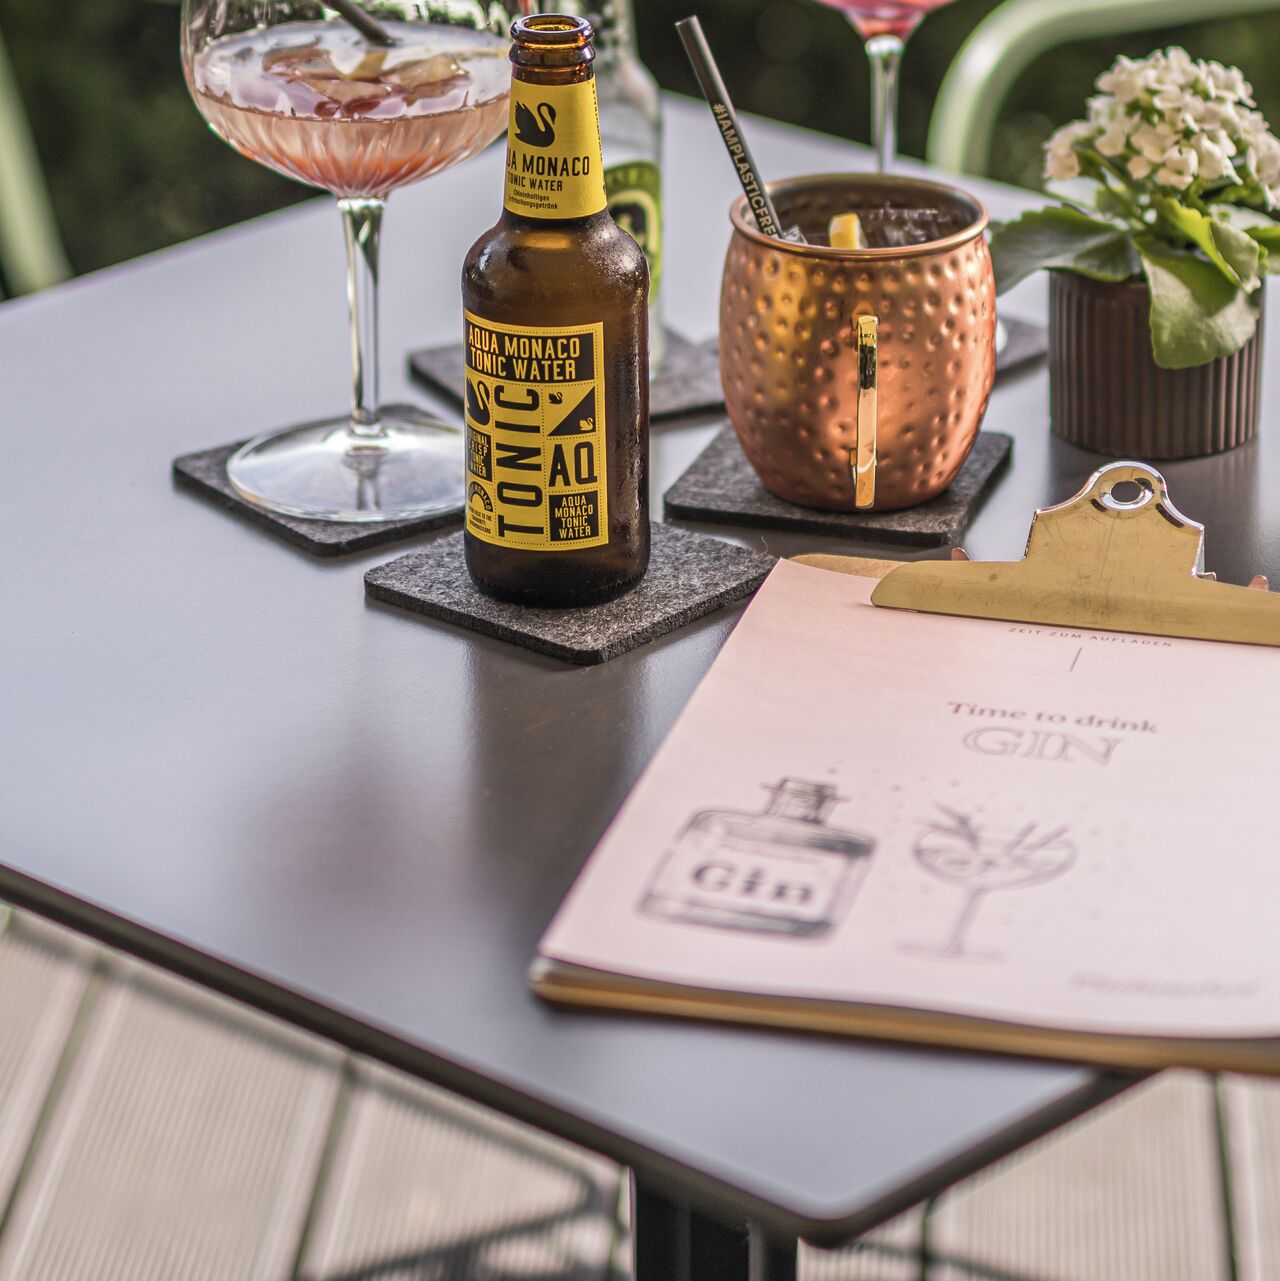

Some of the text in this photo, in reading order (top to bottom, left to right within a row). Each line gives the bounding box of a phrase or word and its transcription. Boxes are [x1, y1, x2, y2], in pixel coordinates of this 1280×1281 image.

[522, 153, 590, 177] MONACO
[507, 171, 563, 192] TONIC WATER
[469, 324, 580, 359] AQUA MONACO
[470, 346, 576, 381] TONIC WATER
[494, 384, 545, 538] TONIC
[548, 441, 598, 487] AQ
[554, 504, 594, 518] MONACO
[561, 495, 587, 507] AQUA
[558, 525, 591, 539] WATER
[561, 516, 588, 528] TONIC
[1008, 626, 1173, 648] ZEIT ZUM AUFLADEN
[947, 700, 1159, 734] Time to drink
[962, 725, 1123, 767] GIN
[690, 862, 816, 908] Gin
